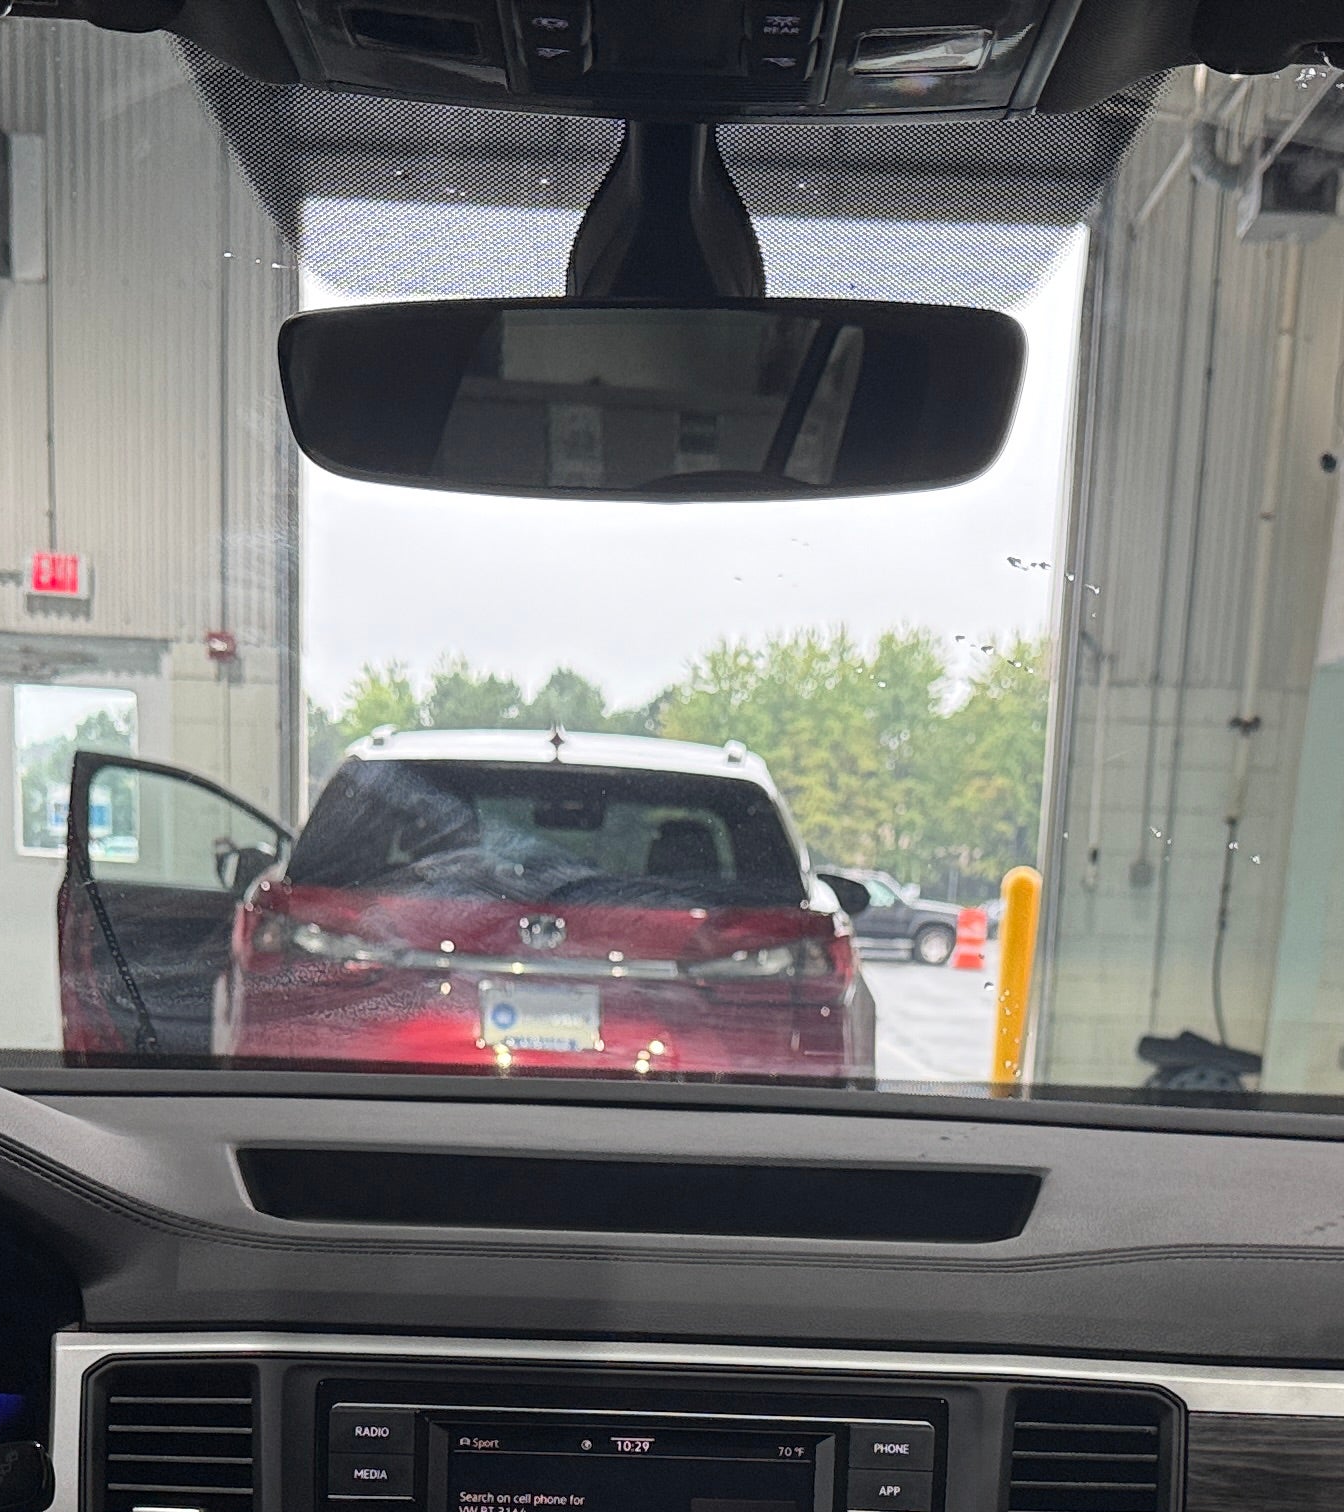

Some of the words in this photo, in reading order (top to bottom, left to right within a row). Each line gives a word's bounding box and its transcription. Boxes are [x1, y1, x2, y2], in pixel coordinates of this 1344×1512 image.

[355, 1426, 390, 1438] RADIO
[472, 1437, 500, 1449] Sport
[616, 1440, 650, 1453] 10:29
[873, 1443, 910, 1455] PHONE
[778, 1446, 792, 1457] 70
[353, 1468, 388, 1480] MEDIA
[878, 1485, 901, 1497] APP
[459, 1491, 494, 1503] Search
[496, 1494, 511, 1503] on
[513, 1493, 531, 1504] cell
[533, 1494, 567, 1506] phone
[569, 1494, 585, 1505] for
